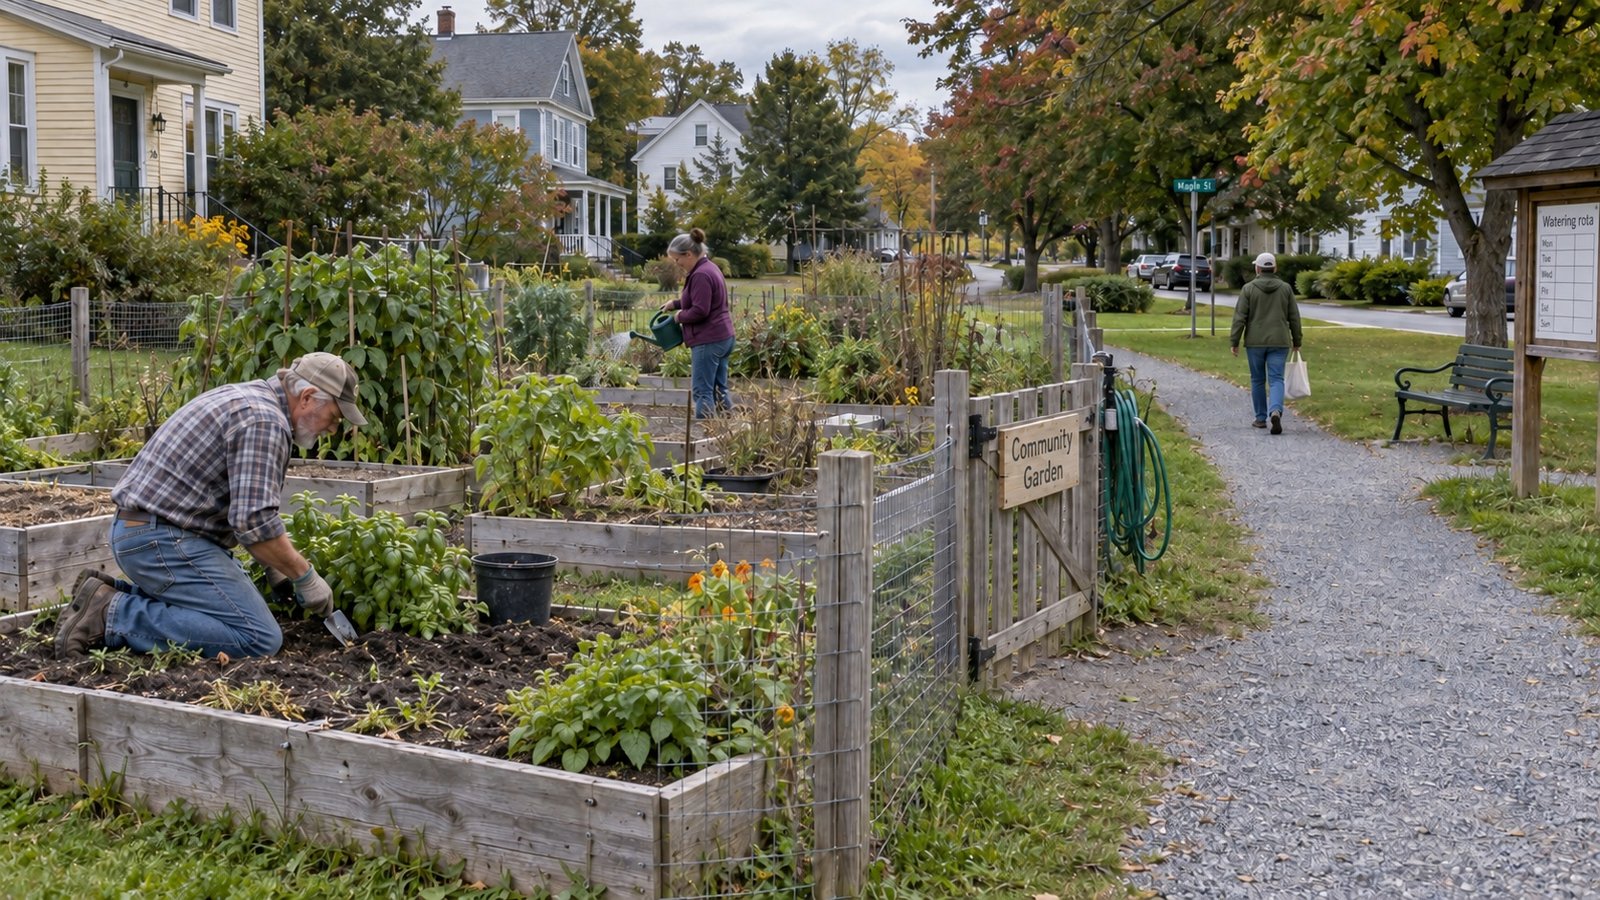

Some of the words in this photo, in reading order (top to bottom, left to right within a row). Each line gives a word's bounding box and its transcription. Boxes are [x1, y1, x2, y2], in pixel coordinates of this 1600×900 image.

[1542, 214, 1577, 230] Watering
[1578, 214, 1594, 226] rota
[1012, 428, 1073, 461] Community
[1023, 460, 1063, 489] Garden
